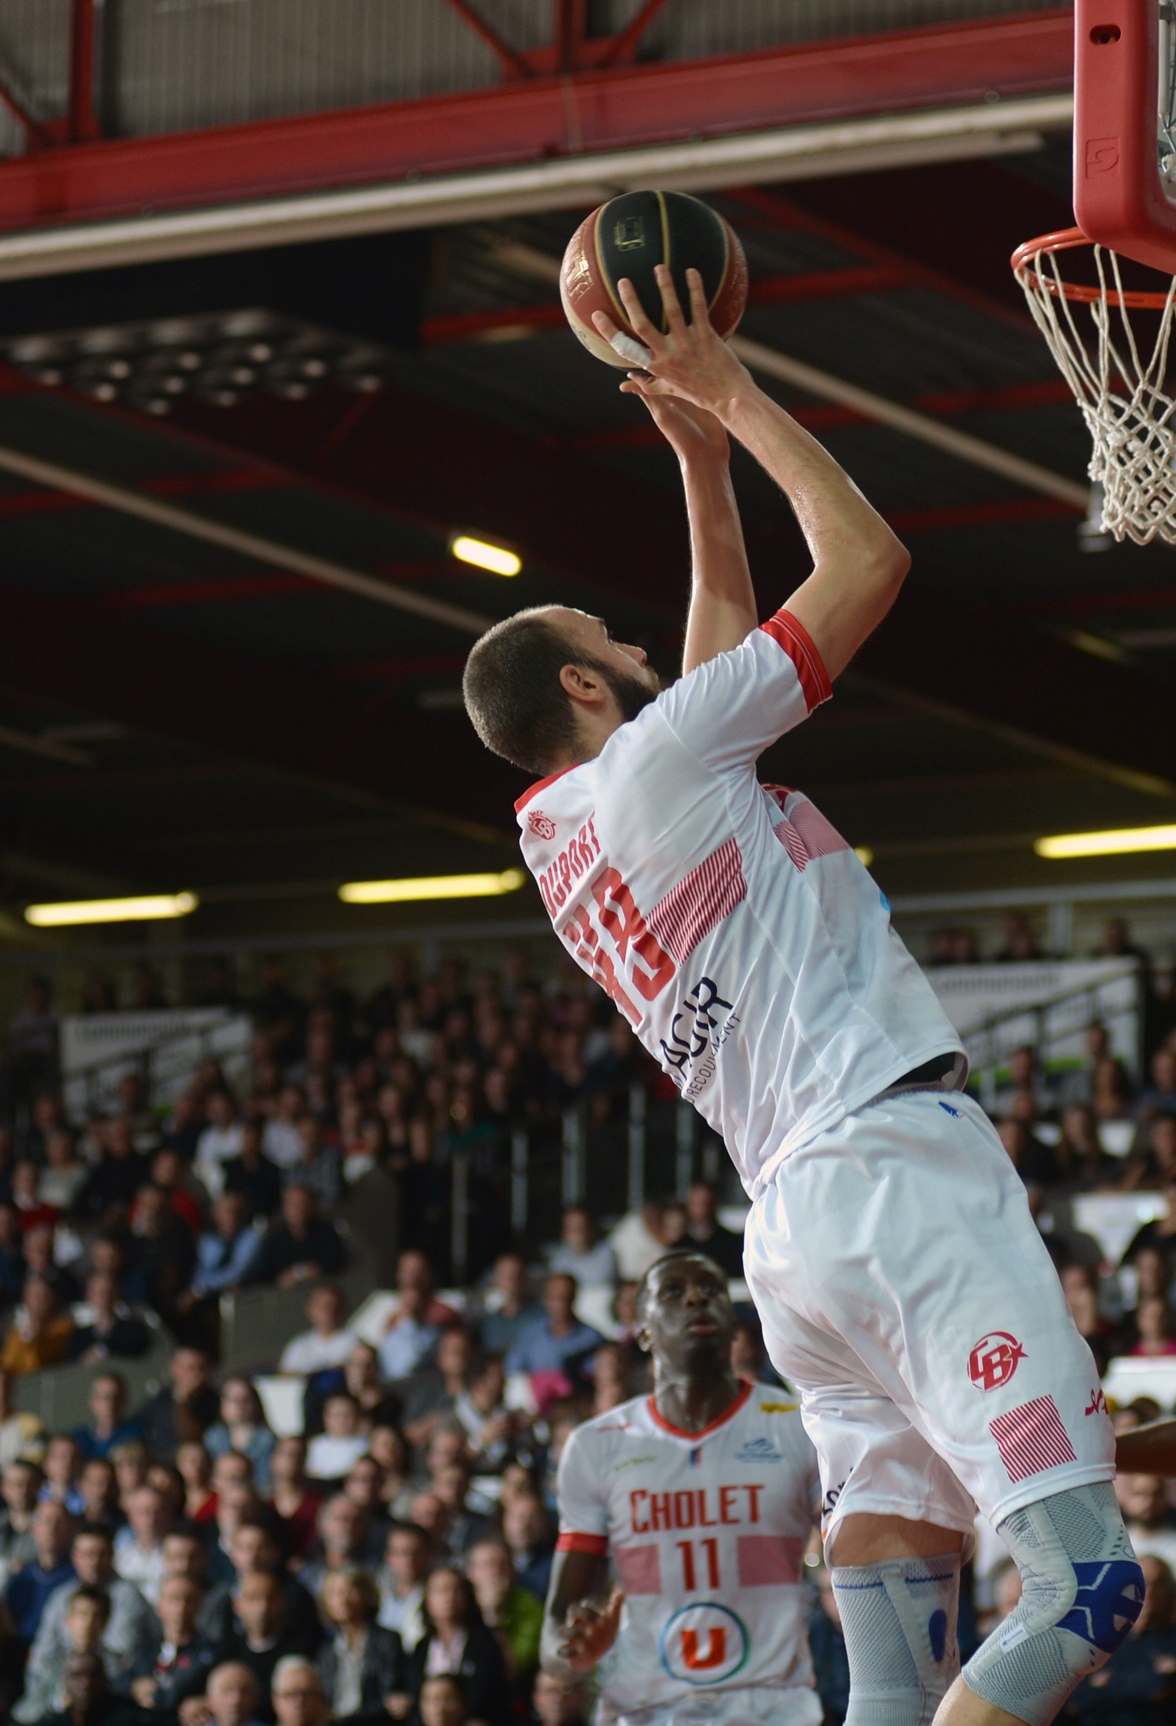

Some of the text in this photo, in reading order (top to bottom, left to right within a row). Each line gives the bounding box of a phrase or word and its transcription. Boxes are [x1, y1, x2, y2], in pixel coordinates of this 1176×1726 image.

[630, 1484, 764, 1534] CHOLET
[677, 1537, 721, 1592] 11
[681, 1627, 725, 1671] U
